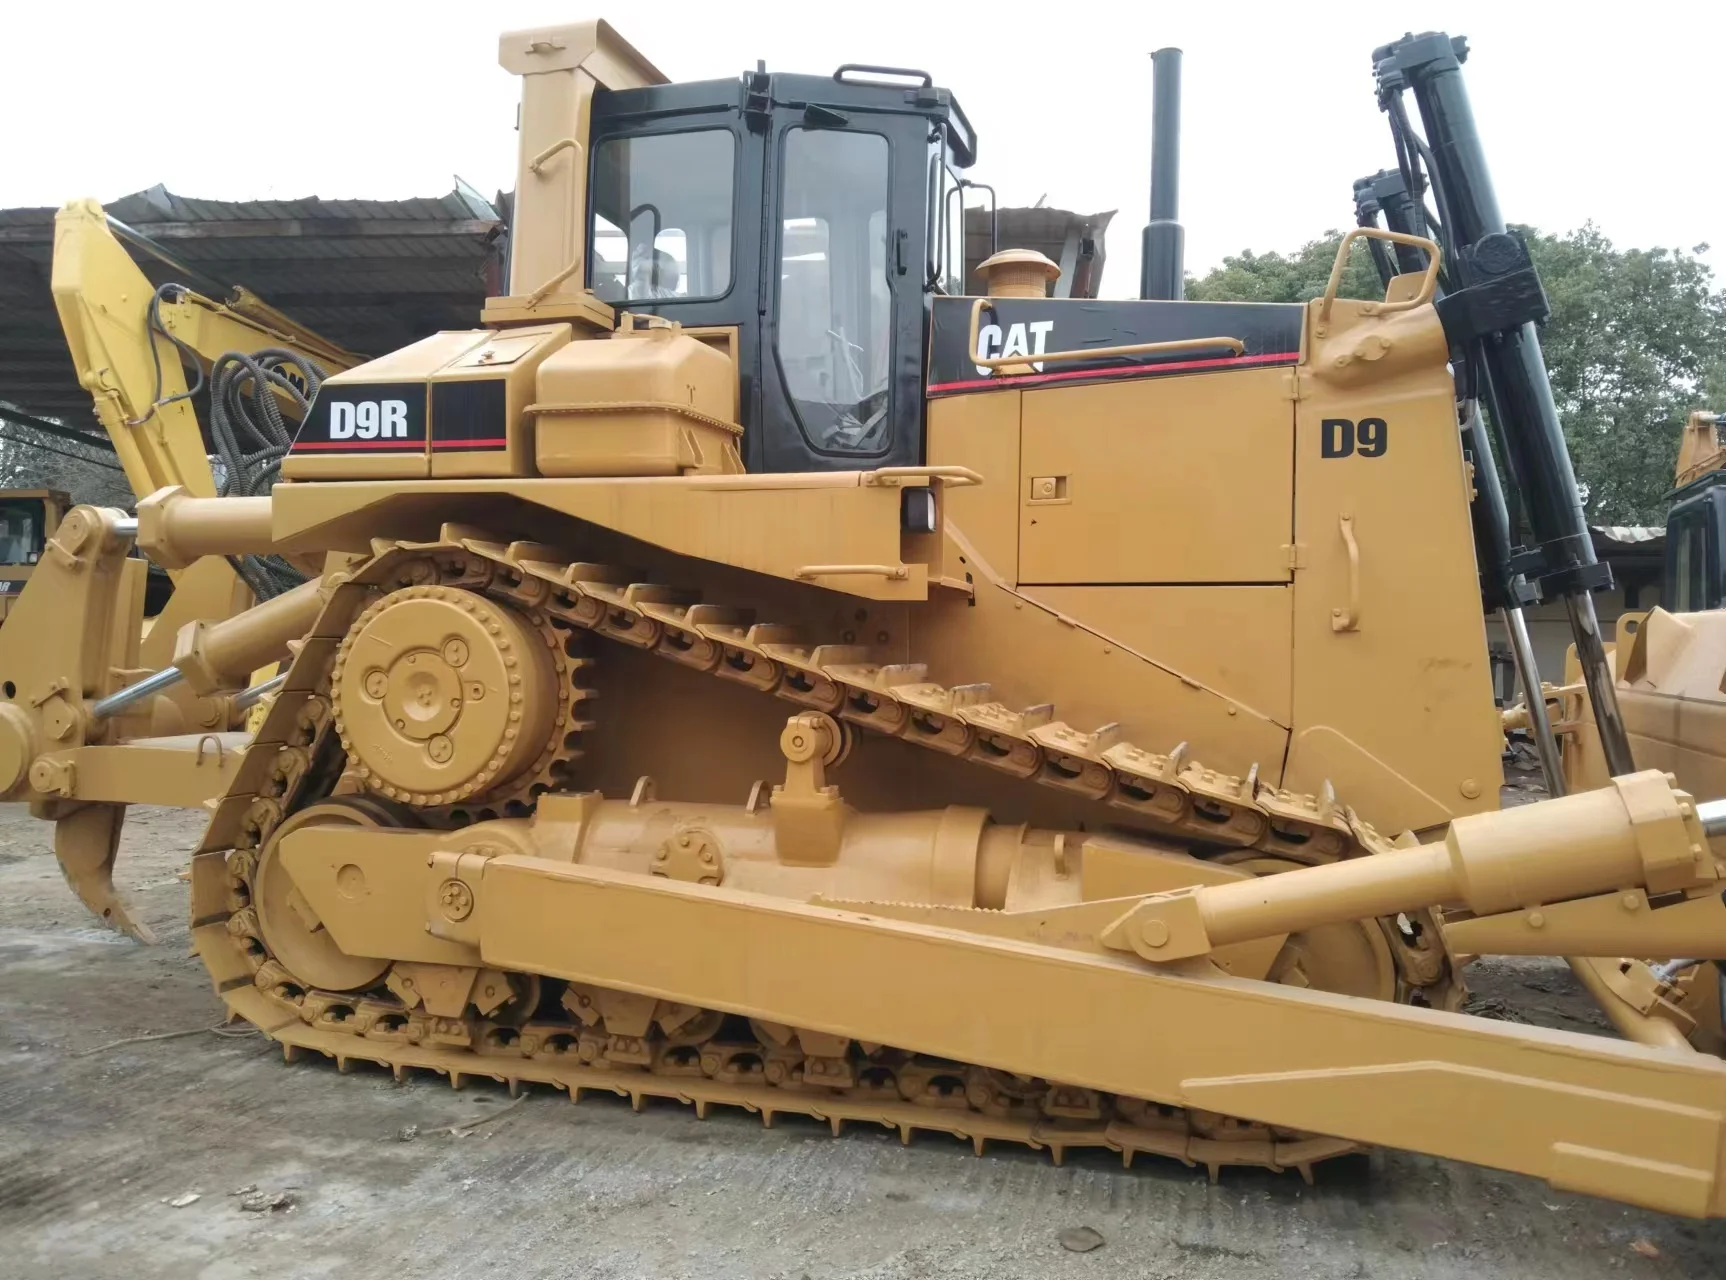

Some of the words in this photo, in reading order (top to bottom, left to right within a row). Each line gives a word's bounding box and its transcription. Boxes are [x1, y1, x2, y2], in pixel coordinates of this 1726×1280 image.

[976, 320, 1054, 376] CAT
[329, 399, 408, 439] D9R
[1320, 417, 1388, 459] D9
